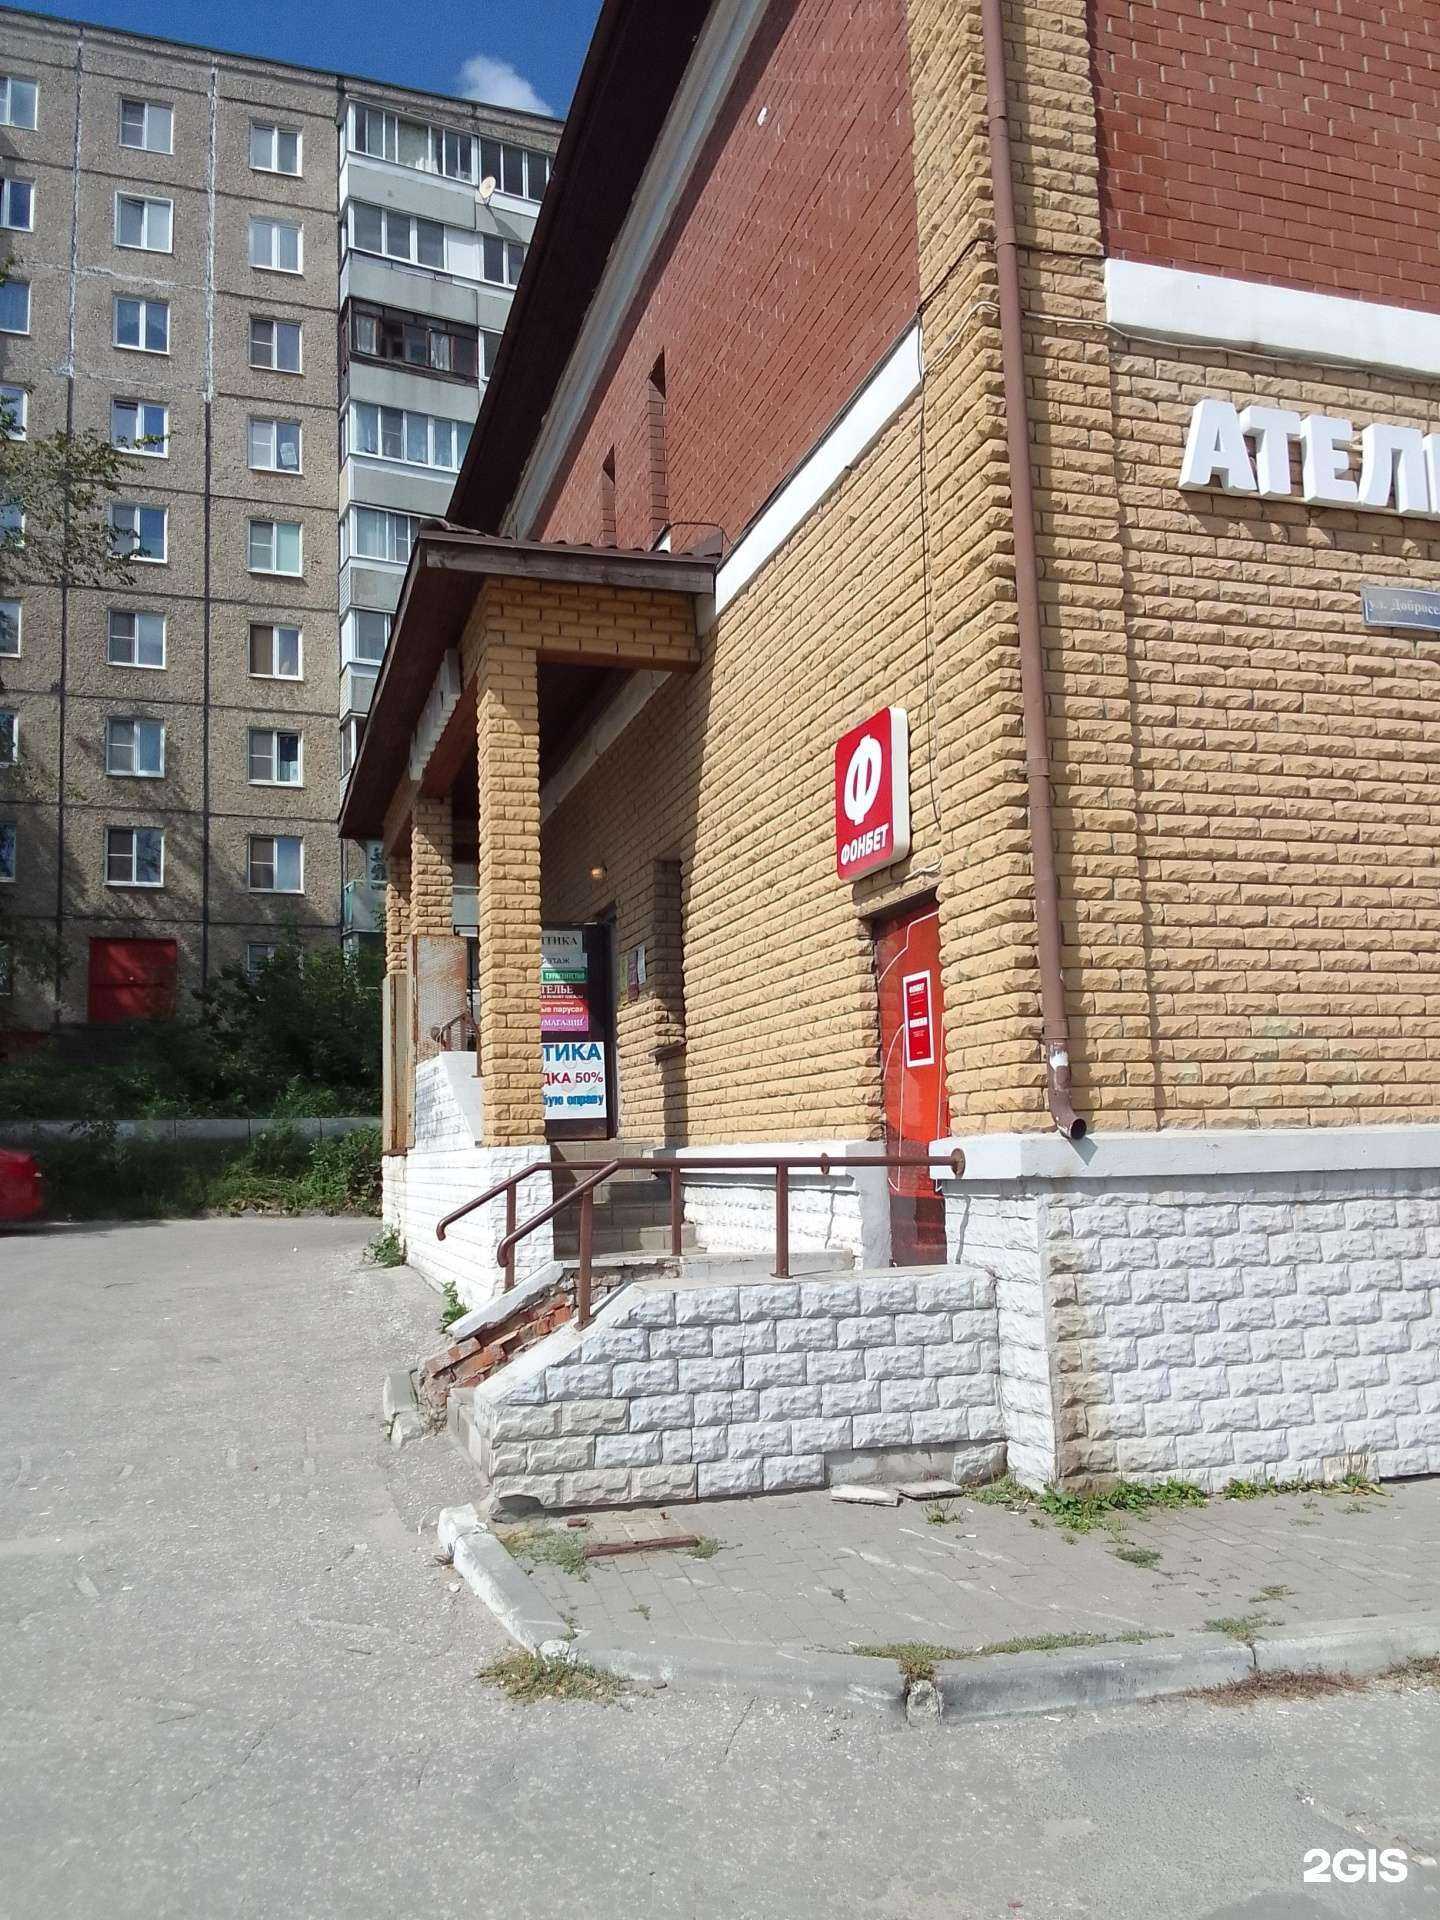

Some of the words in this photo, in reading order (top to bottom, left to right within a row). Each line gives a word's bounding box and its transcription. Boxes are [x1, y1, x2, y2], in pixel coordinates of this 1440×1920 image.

[844, 734, 882, 826] Ф
[840, 823, 889, 866] ФОНБЕТ
[541, 985, 574, 994] ТЕЛЬЕ
[541, 1017, 584, 1027] МАГАЗИН
[543, 1043, 602, 1062] ТИКА
[543, 1072, 571, 1086] ДКА
[575, 1072, 604, 1084] 50%
[543, 1095, 564, 1107] бую
